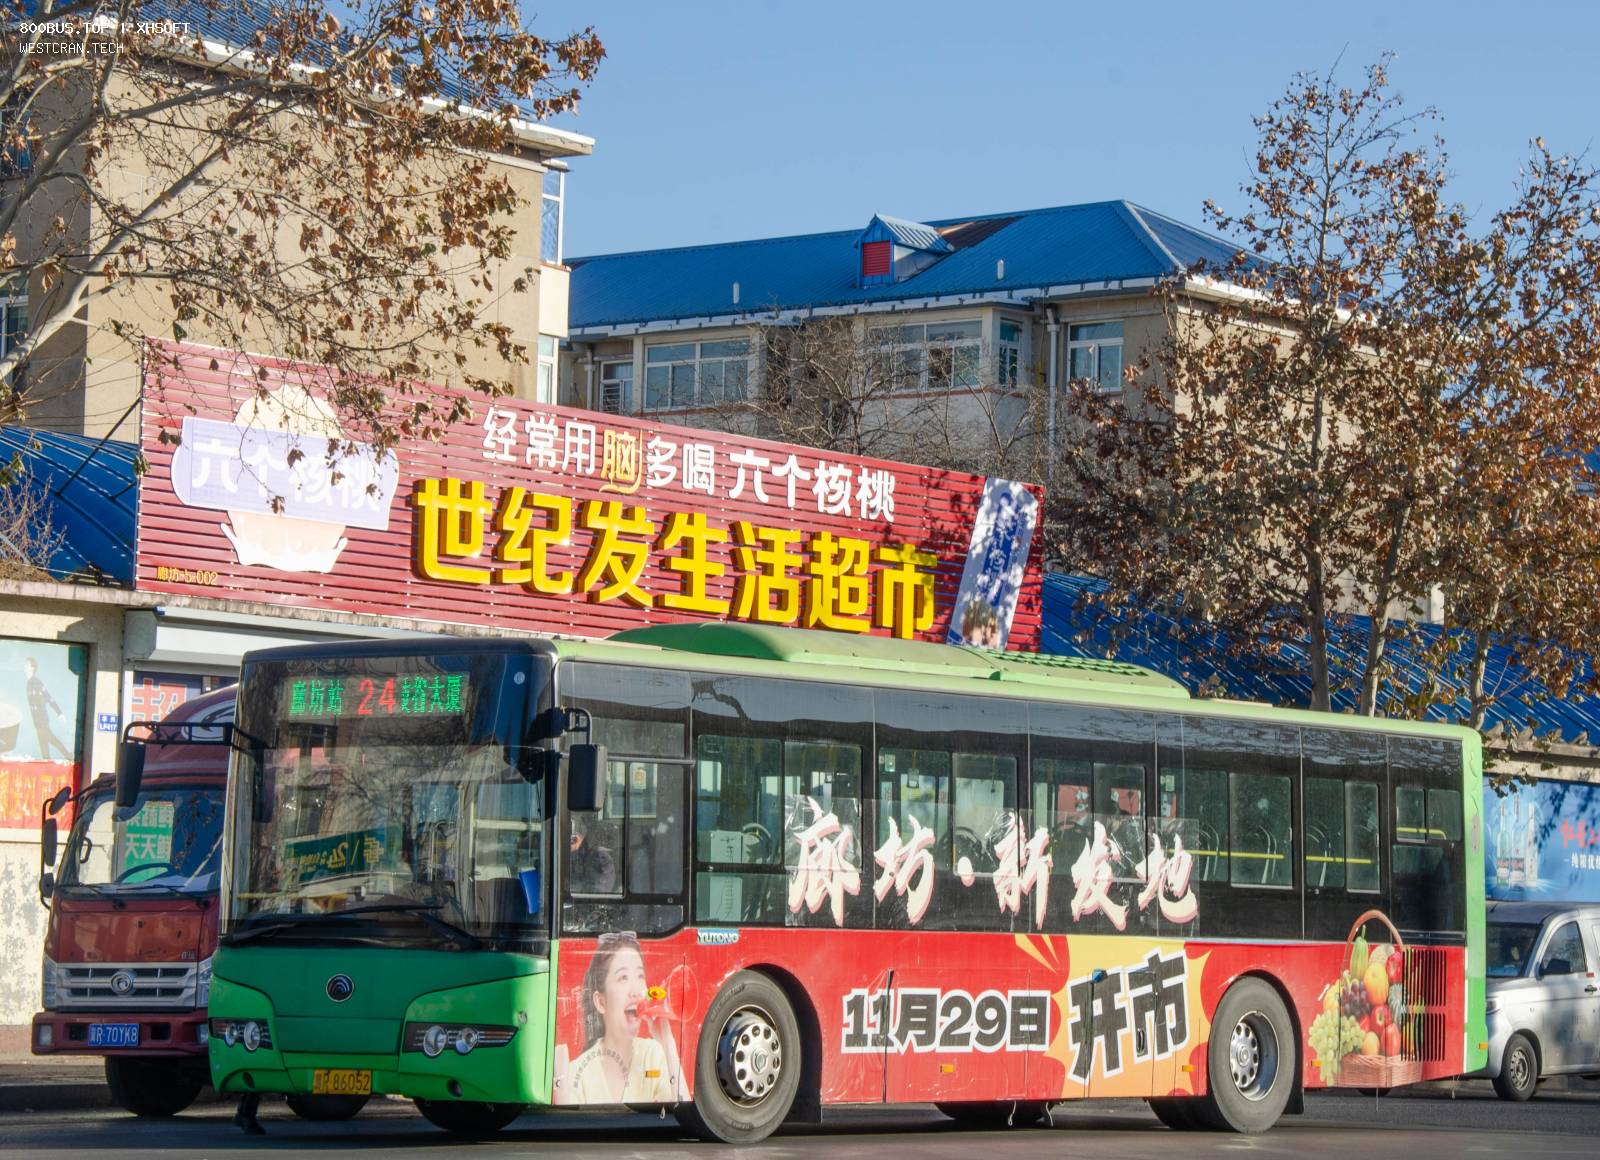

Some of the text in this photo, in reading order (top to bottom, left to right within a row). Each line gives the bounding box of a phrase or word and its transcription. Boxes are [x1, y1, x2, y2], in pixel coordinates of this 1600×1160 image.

[414, 477, 938, 640] 世纪发生活超市
[358, 677, 396, 715] 24
[842, 988, 1052, 1054] 11月29日
[1068, 949, 1189, 1084] 开市
